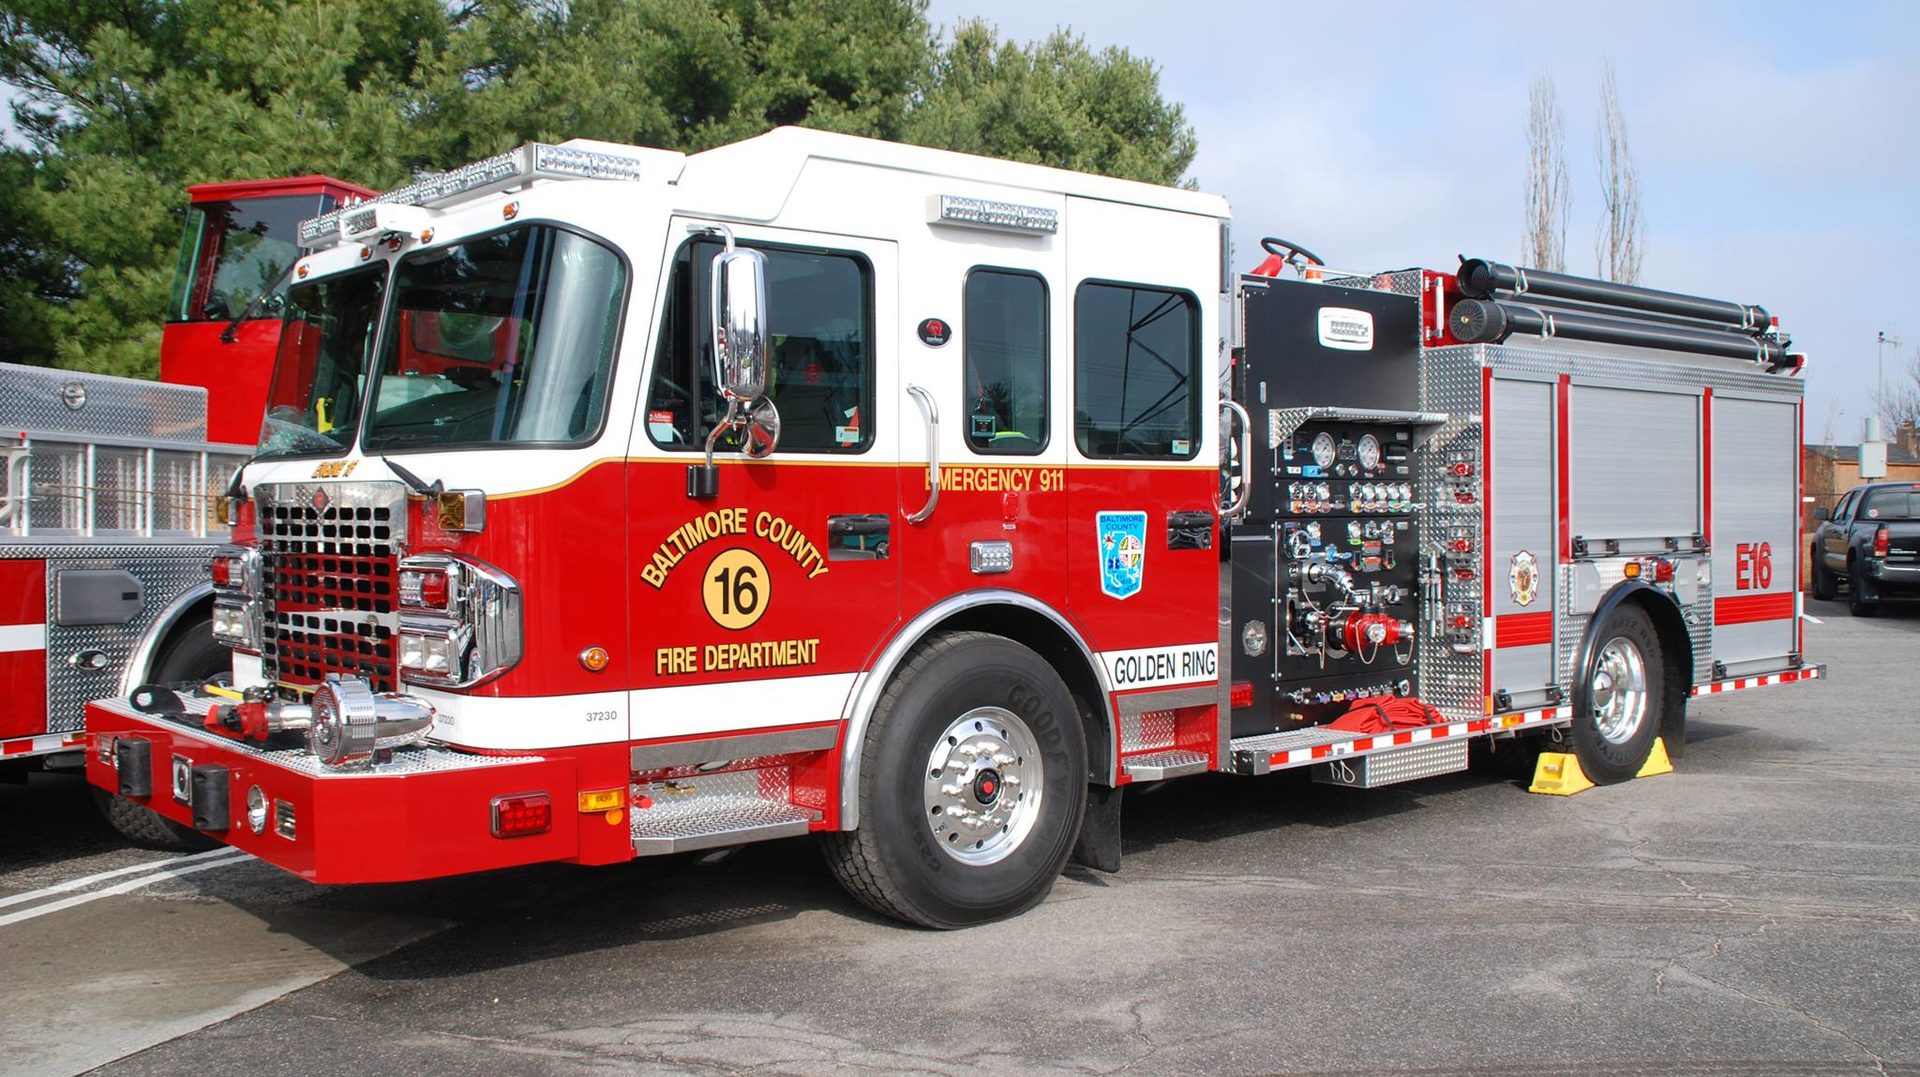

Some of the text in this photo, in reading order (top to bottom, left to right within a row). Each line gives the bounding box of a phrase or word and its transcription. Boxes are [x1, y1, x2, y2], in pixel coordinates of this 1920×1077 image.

[1039, 469, 1064, 492] 911
[1101, 515, 1143, 523] BALTIMORE
[640, 507, 829, 590] BALTIMORE COUNTY
[1736, 542, 1772, 590] E16
[714, 565, 758, 615] 16
[656, 638, 820, 676] FIRE DEPARTMENT
[1114, 648, 1216, 685] GOLDEN RING
[586, 710, 617, 722] 37230
